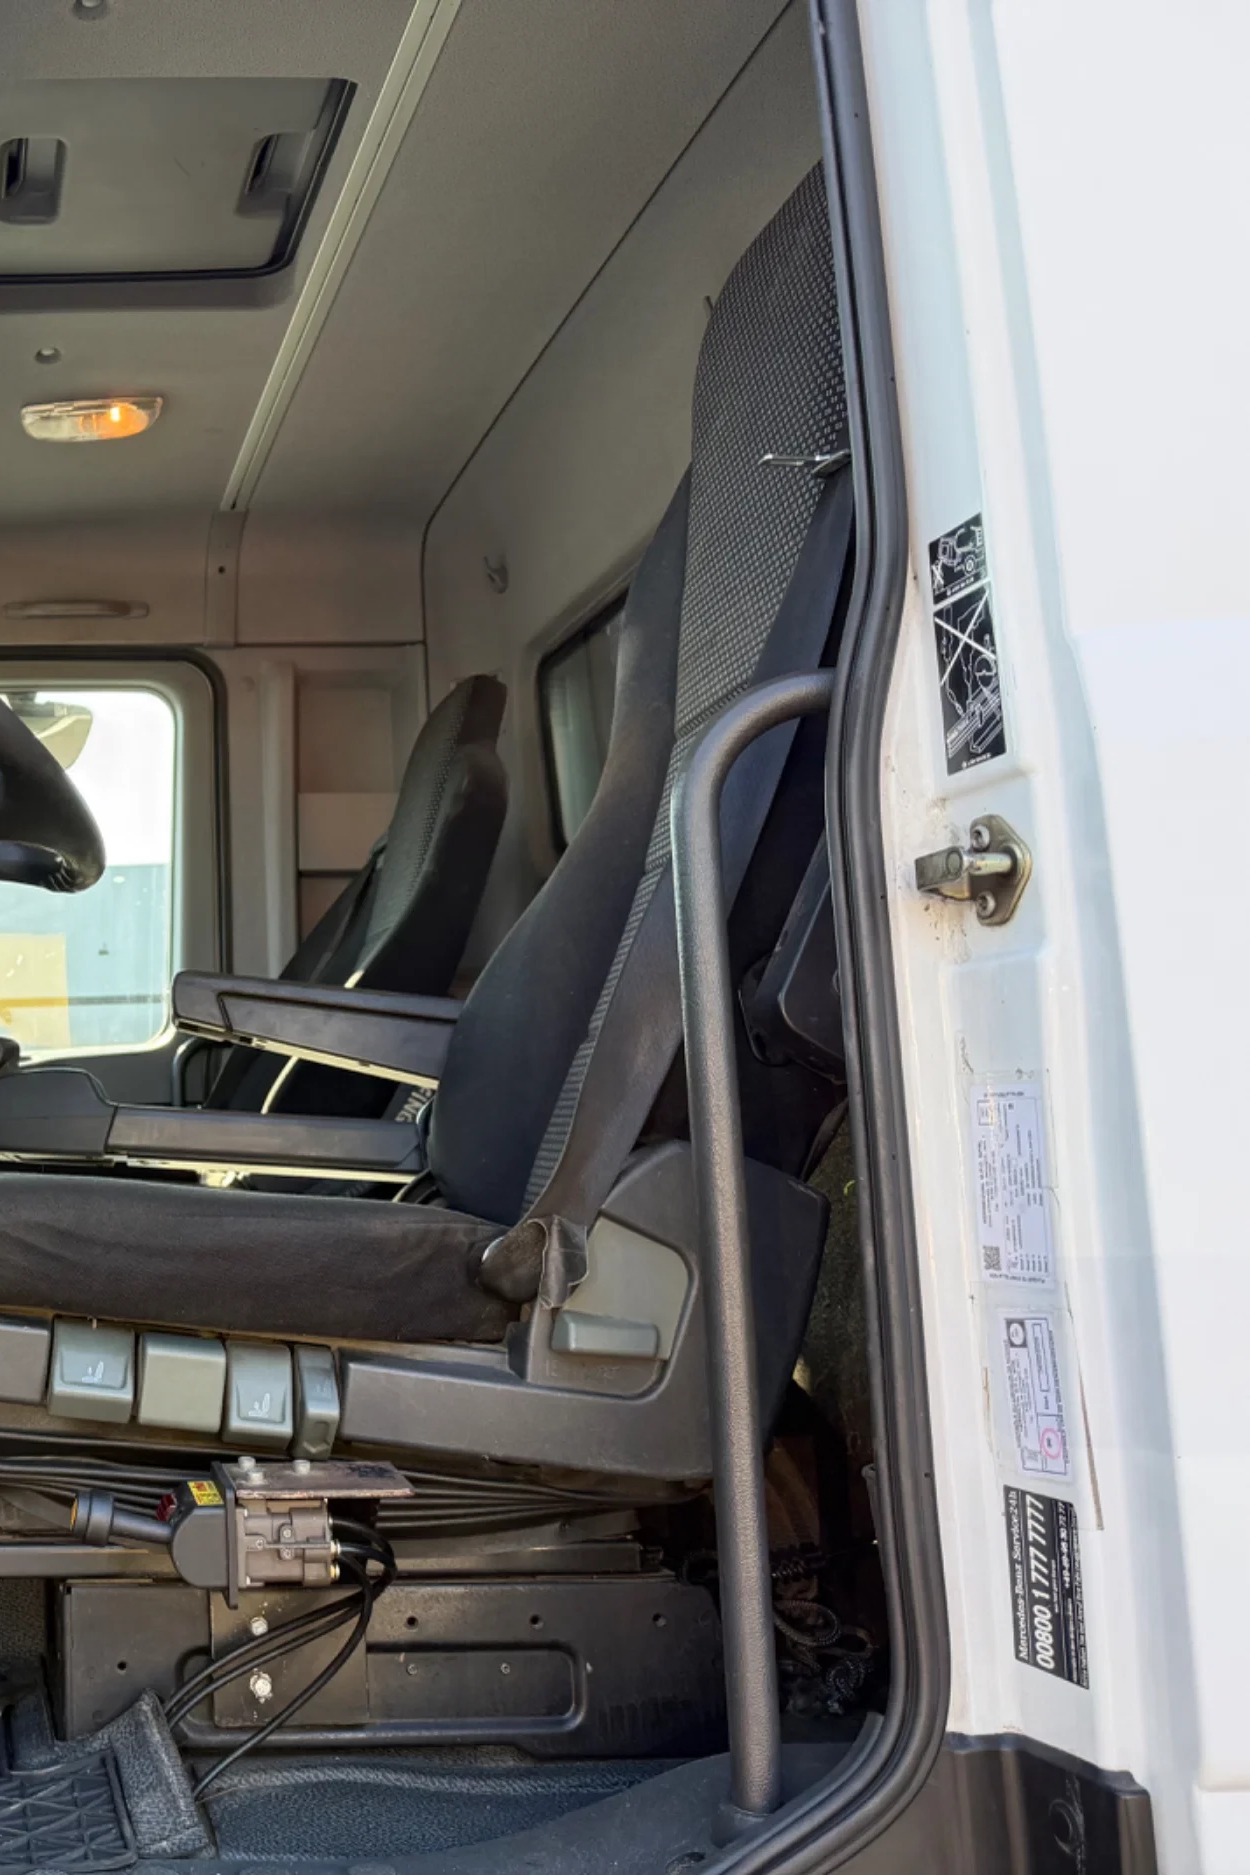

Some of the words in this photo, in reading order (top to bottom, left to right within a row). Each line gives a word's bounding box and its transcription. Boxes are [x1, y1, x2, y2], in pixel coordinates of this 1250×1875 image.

[1025, 1494, 1047, 1545] 7777
[1057, 1501, 1065, 1514] 77
[1029, 1546, 1050, 1587] 777
[1014, 1562, 1028, 1660] Mercedes-Benz
[1031, 1589, 1050, 1599] 1
[1032, 1604, 1055, 1669] 00800
